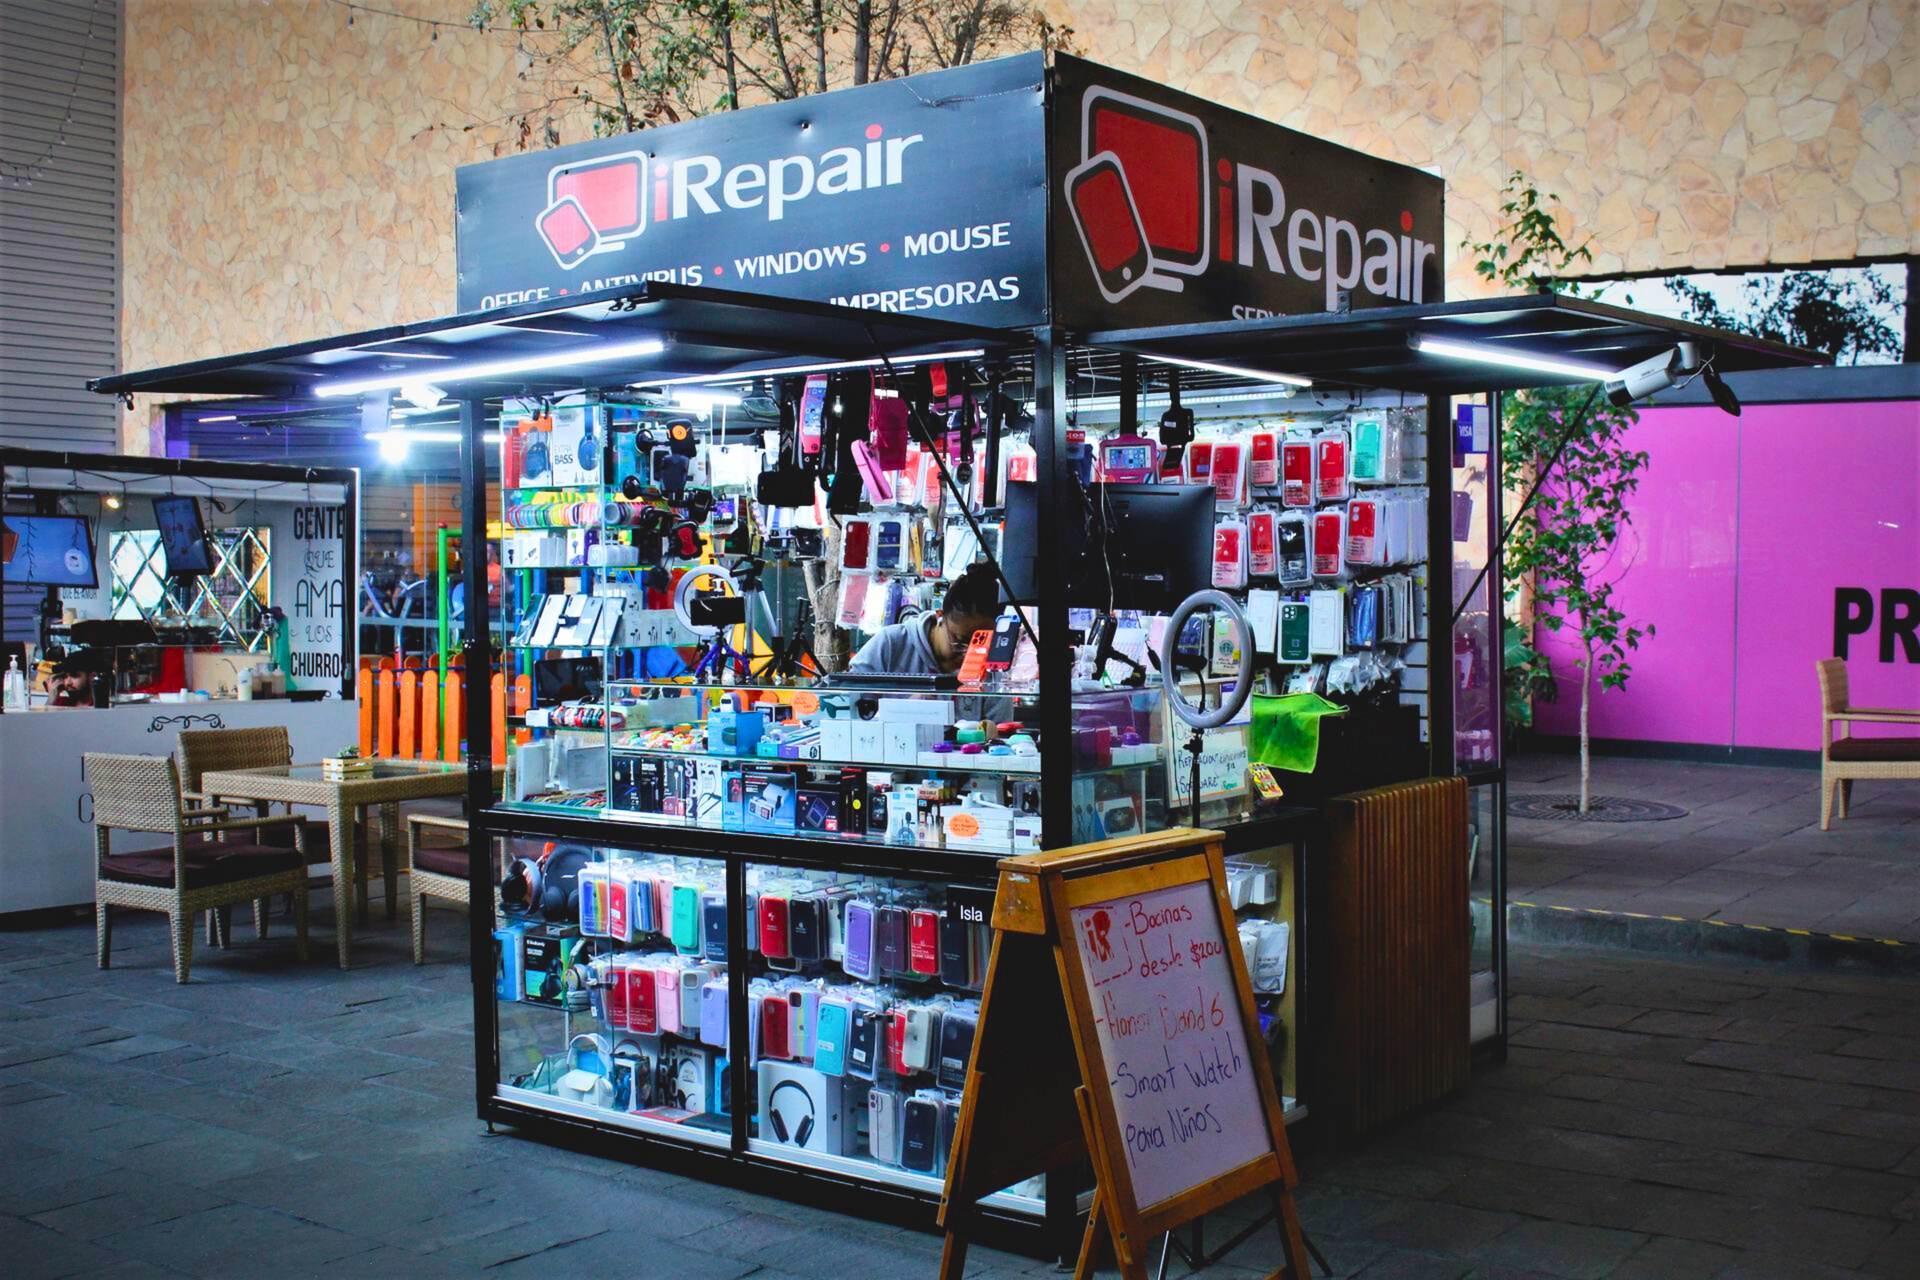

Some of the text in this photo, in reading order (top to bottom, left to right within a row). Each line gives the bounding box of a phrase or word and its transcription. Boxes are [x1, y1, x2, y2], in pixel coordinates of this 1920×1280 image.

[654, 123, 923, 222] iRepair
[734, 242, 867, 280] WINDOWS
[903, 222, 1012, 258] MOUSE
[1217, 158, 1436, 313] iRepair
[830, 276, 1021, 313] MPRESORAS
[1458, 425, 1472, 437] VISA
[554, 453, 574, 465] BASS
[294, 505, 345, 540] GENTE
[295, 578, 344, 618] AMA
[1833, 586, 1920, 664] PR
[290, 651, 344, 678] CHURRO
[960, 904, 984, 923] Isla
[1184, 1031, 1243, 1089] Watch
